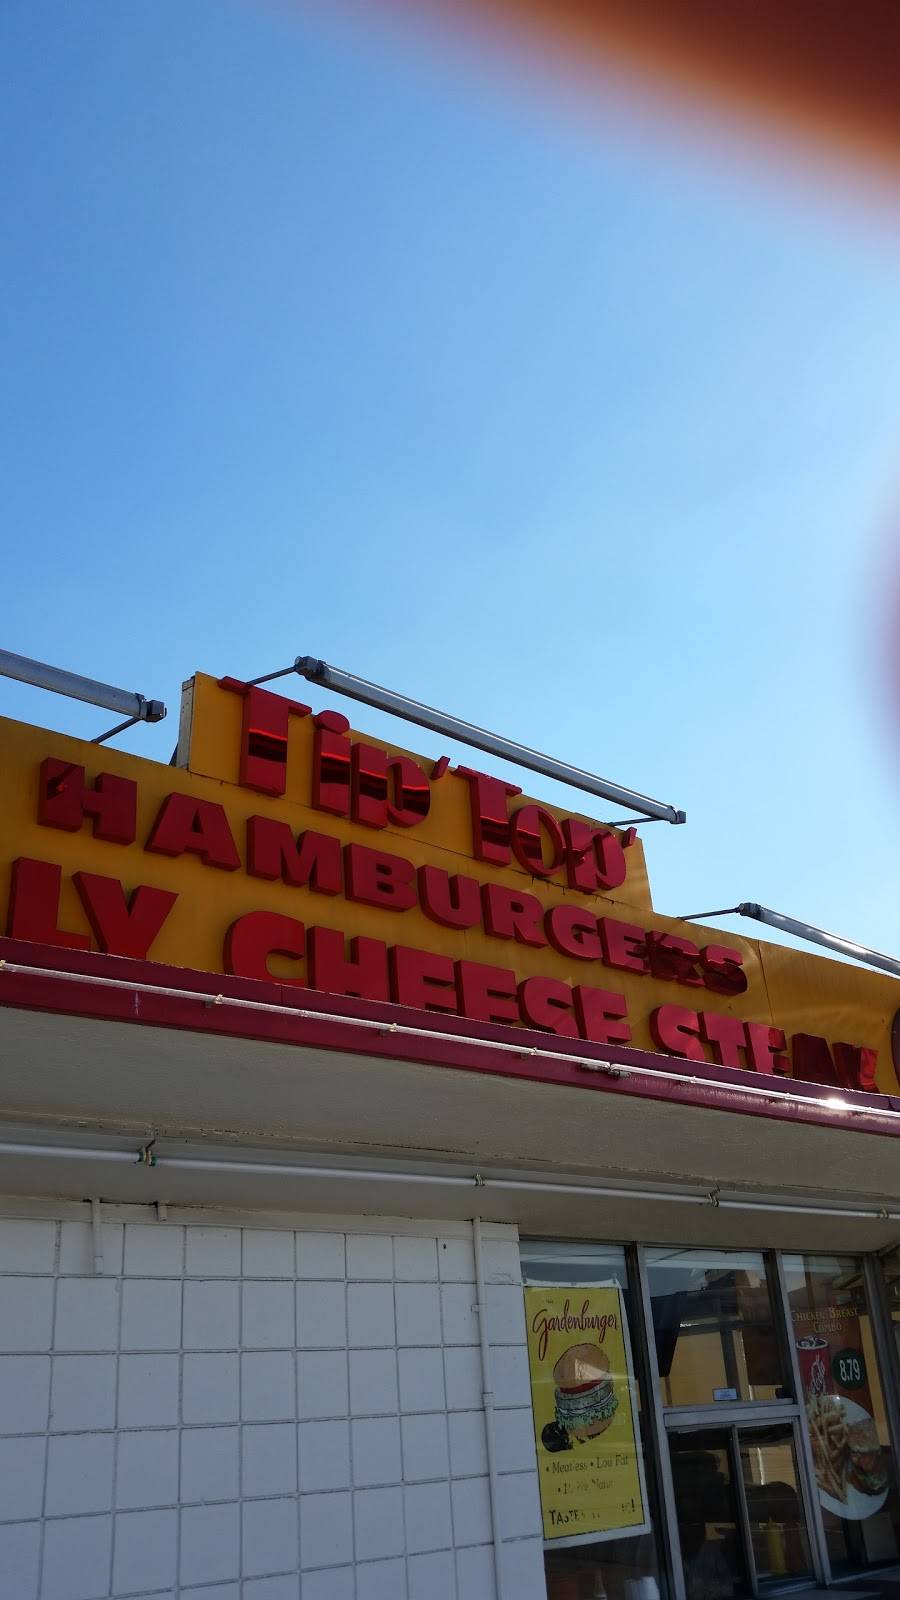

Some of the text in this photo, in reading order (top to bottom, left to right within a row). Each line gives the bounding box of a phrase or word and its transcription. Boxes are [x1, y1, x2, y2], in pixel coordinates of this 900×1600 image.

[38, 757, 747, 996] HAMBURGERS
[7, 857, 179, 960] LY
[223, 911, 632, 1044] CHEESE
[532, 1299, 617, 1361] Gardenburger
[840, 1358, 860, 1381] 8.79
[552, 1461, 588, 1474] Meatess
